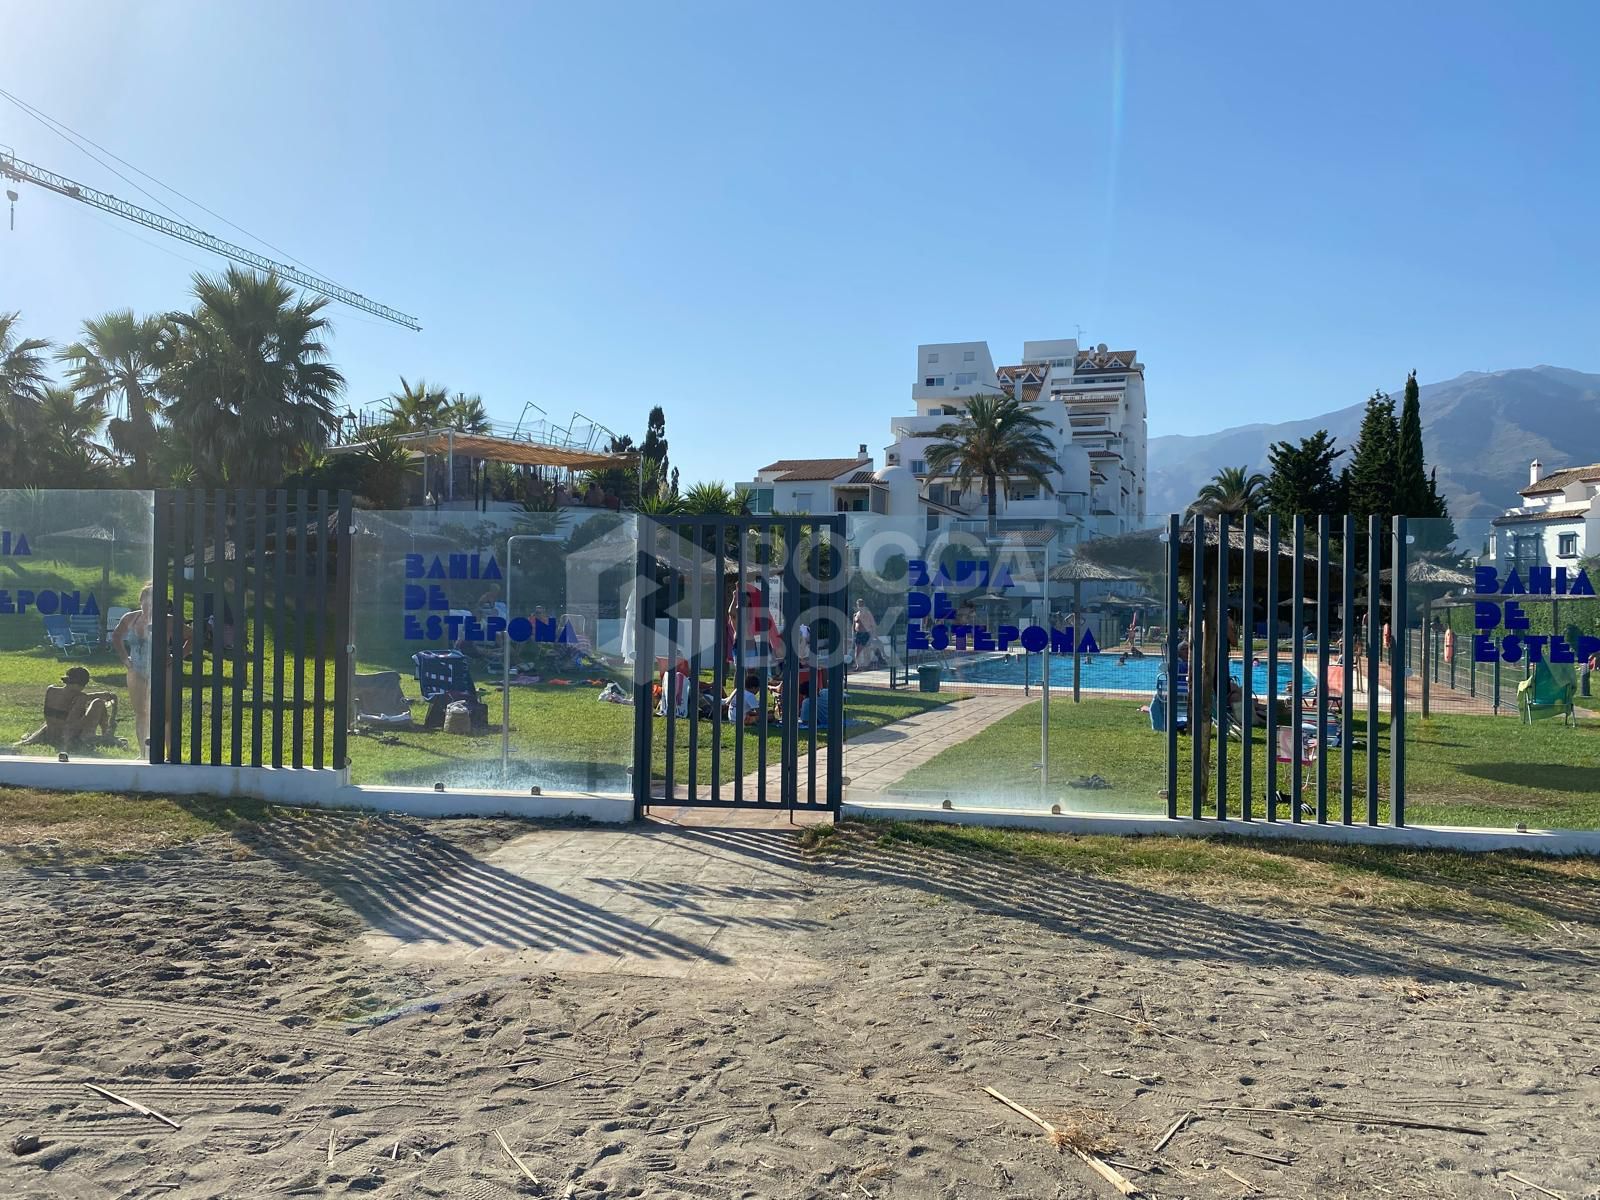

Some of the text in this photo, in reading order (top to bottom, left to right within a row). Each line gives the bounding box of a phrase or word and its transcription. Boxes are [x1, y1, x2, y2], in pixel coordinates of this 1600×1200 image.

[405, 554, 503, 579] BAHIA
[908, 560, 1015, 587] BAHIA
[1475, 566, 1596, 595] BAHIA
[405, 585, 449, 610] DE
[908, 592, 956, 619] DE
[404, 615, 578, 643] ESTEPONA
[1475, 601, 1529, 630] DE
[908, 624, 1101, 653] ESTEPONA
